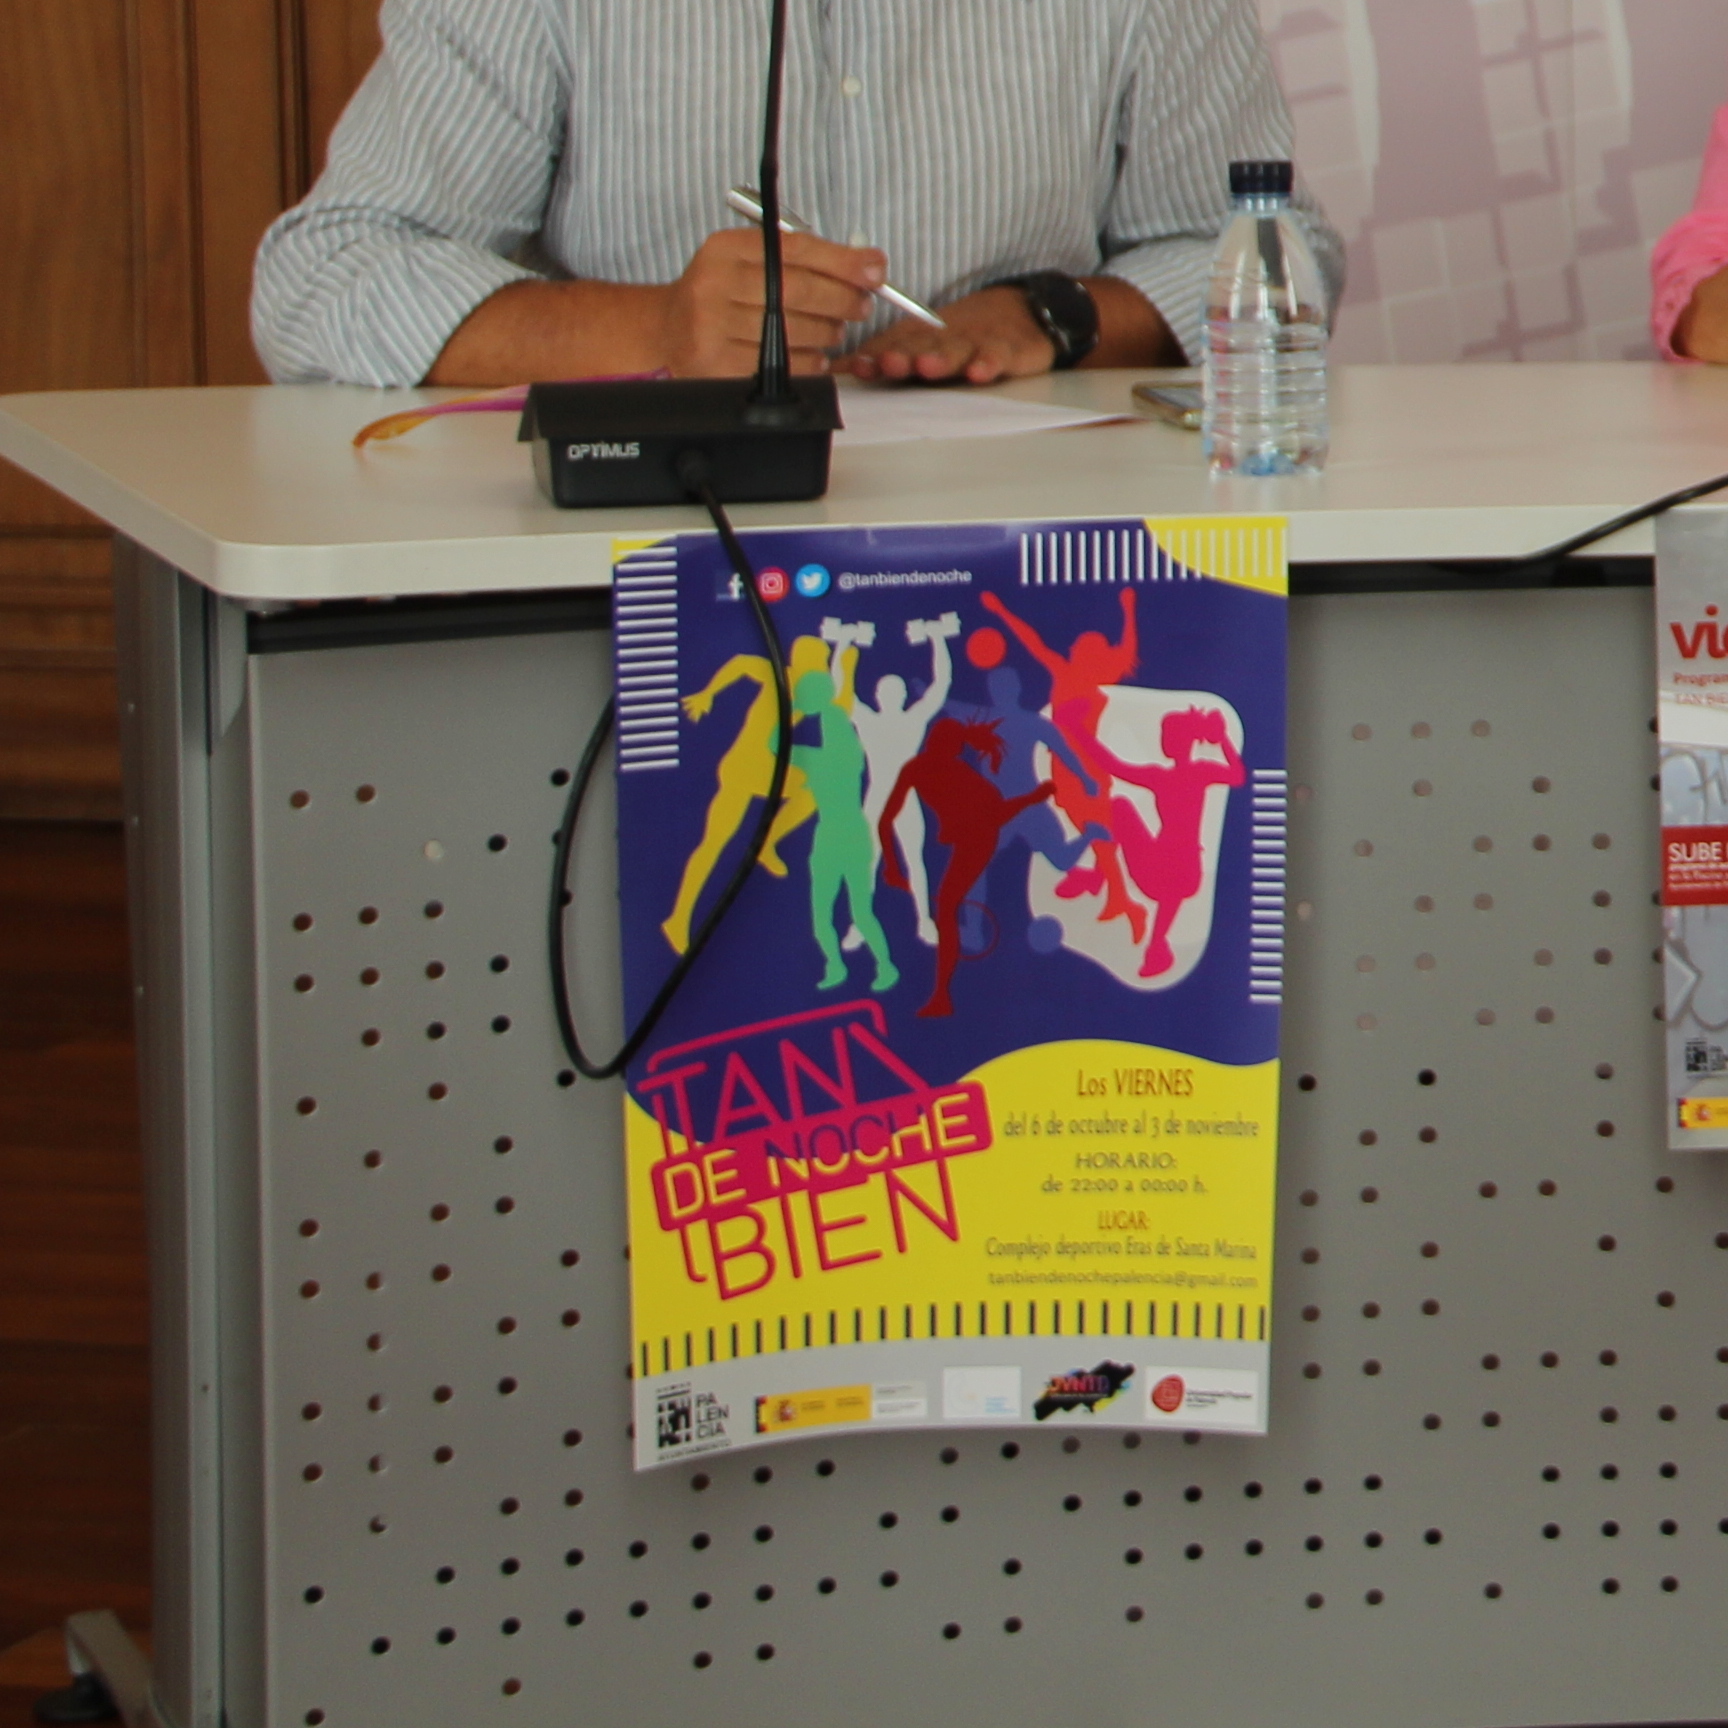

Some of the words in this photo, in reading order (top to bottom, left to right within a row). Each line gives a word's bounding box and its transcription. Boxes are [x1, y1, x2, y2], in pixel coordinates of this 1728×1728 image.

[567, 440, 640, 461] OPTIMUS
[838, 569, 973, 590] @tanbiendenoche
[1668, 841, 1722, 862] SUBE
[636, 1024, 860, 1154] TAN
[1077, 1069, 1108, 1097] Los
[1113, 1069, 1194, 1098] VIERNES
[1003, 1112, 1027, 1136] del
[1031, 1114, 1040, 1136] 6
[1046, 1111, 1063, 1135] de
[1069, 1111, 1129, 1135] octubre
[1133, 1110, 1147, 1135] al
[1151, 1116, 1160, 1139] 3
[1165, 1111, 1182, 1135] de
[1186, 1111, 1260, 1137] noviembre
[663, 1148, 748, 1221] DE
[765, 1091, 978, 1189] NOCHE
[1075, 1152, 1178, 1170] HORARIO:
[1041, 1174, 1063, 1193] de
[1070, 1178, 1119, 1193] 22:00
[1124, 1180, 1135, 1193] a
[1140, 1178, 1188, 1193] 00:00
[707, 1156, 960, 1301] BIEN
[986, 1236, 1053, 1261] Complejo
[1055, 1235, 1122, 1262] deportivo
[1125, 1236, 1152, 1256] Eras
[1157, 1235, 1172, 1256] de
[1176, 1237, 1210, 1258] Santa
[1214, 1238, 1257, 1260] Marina
[696, 1392, 718, 1409] PA
[696, 1405, 731, 1423] LEN
[697, 1422, 727, 1440] CIA
